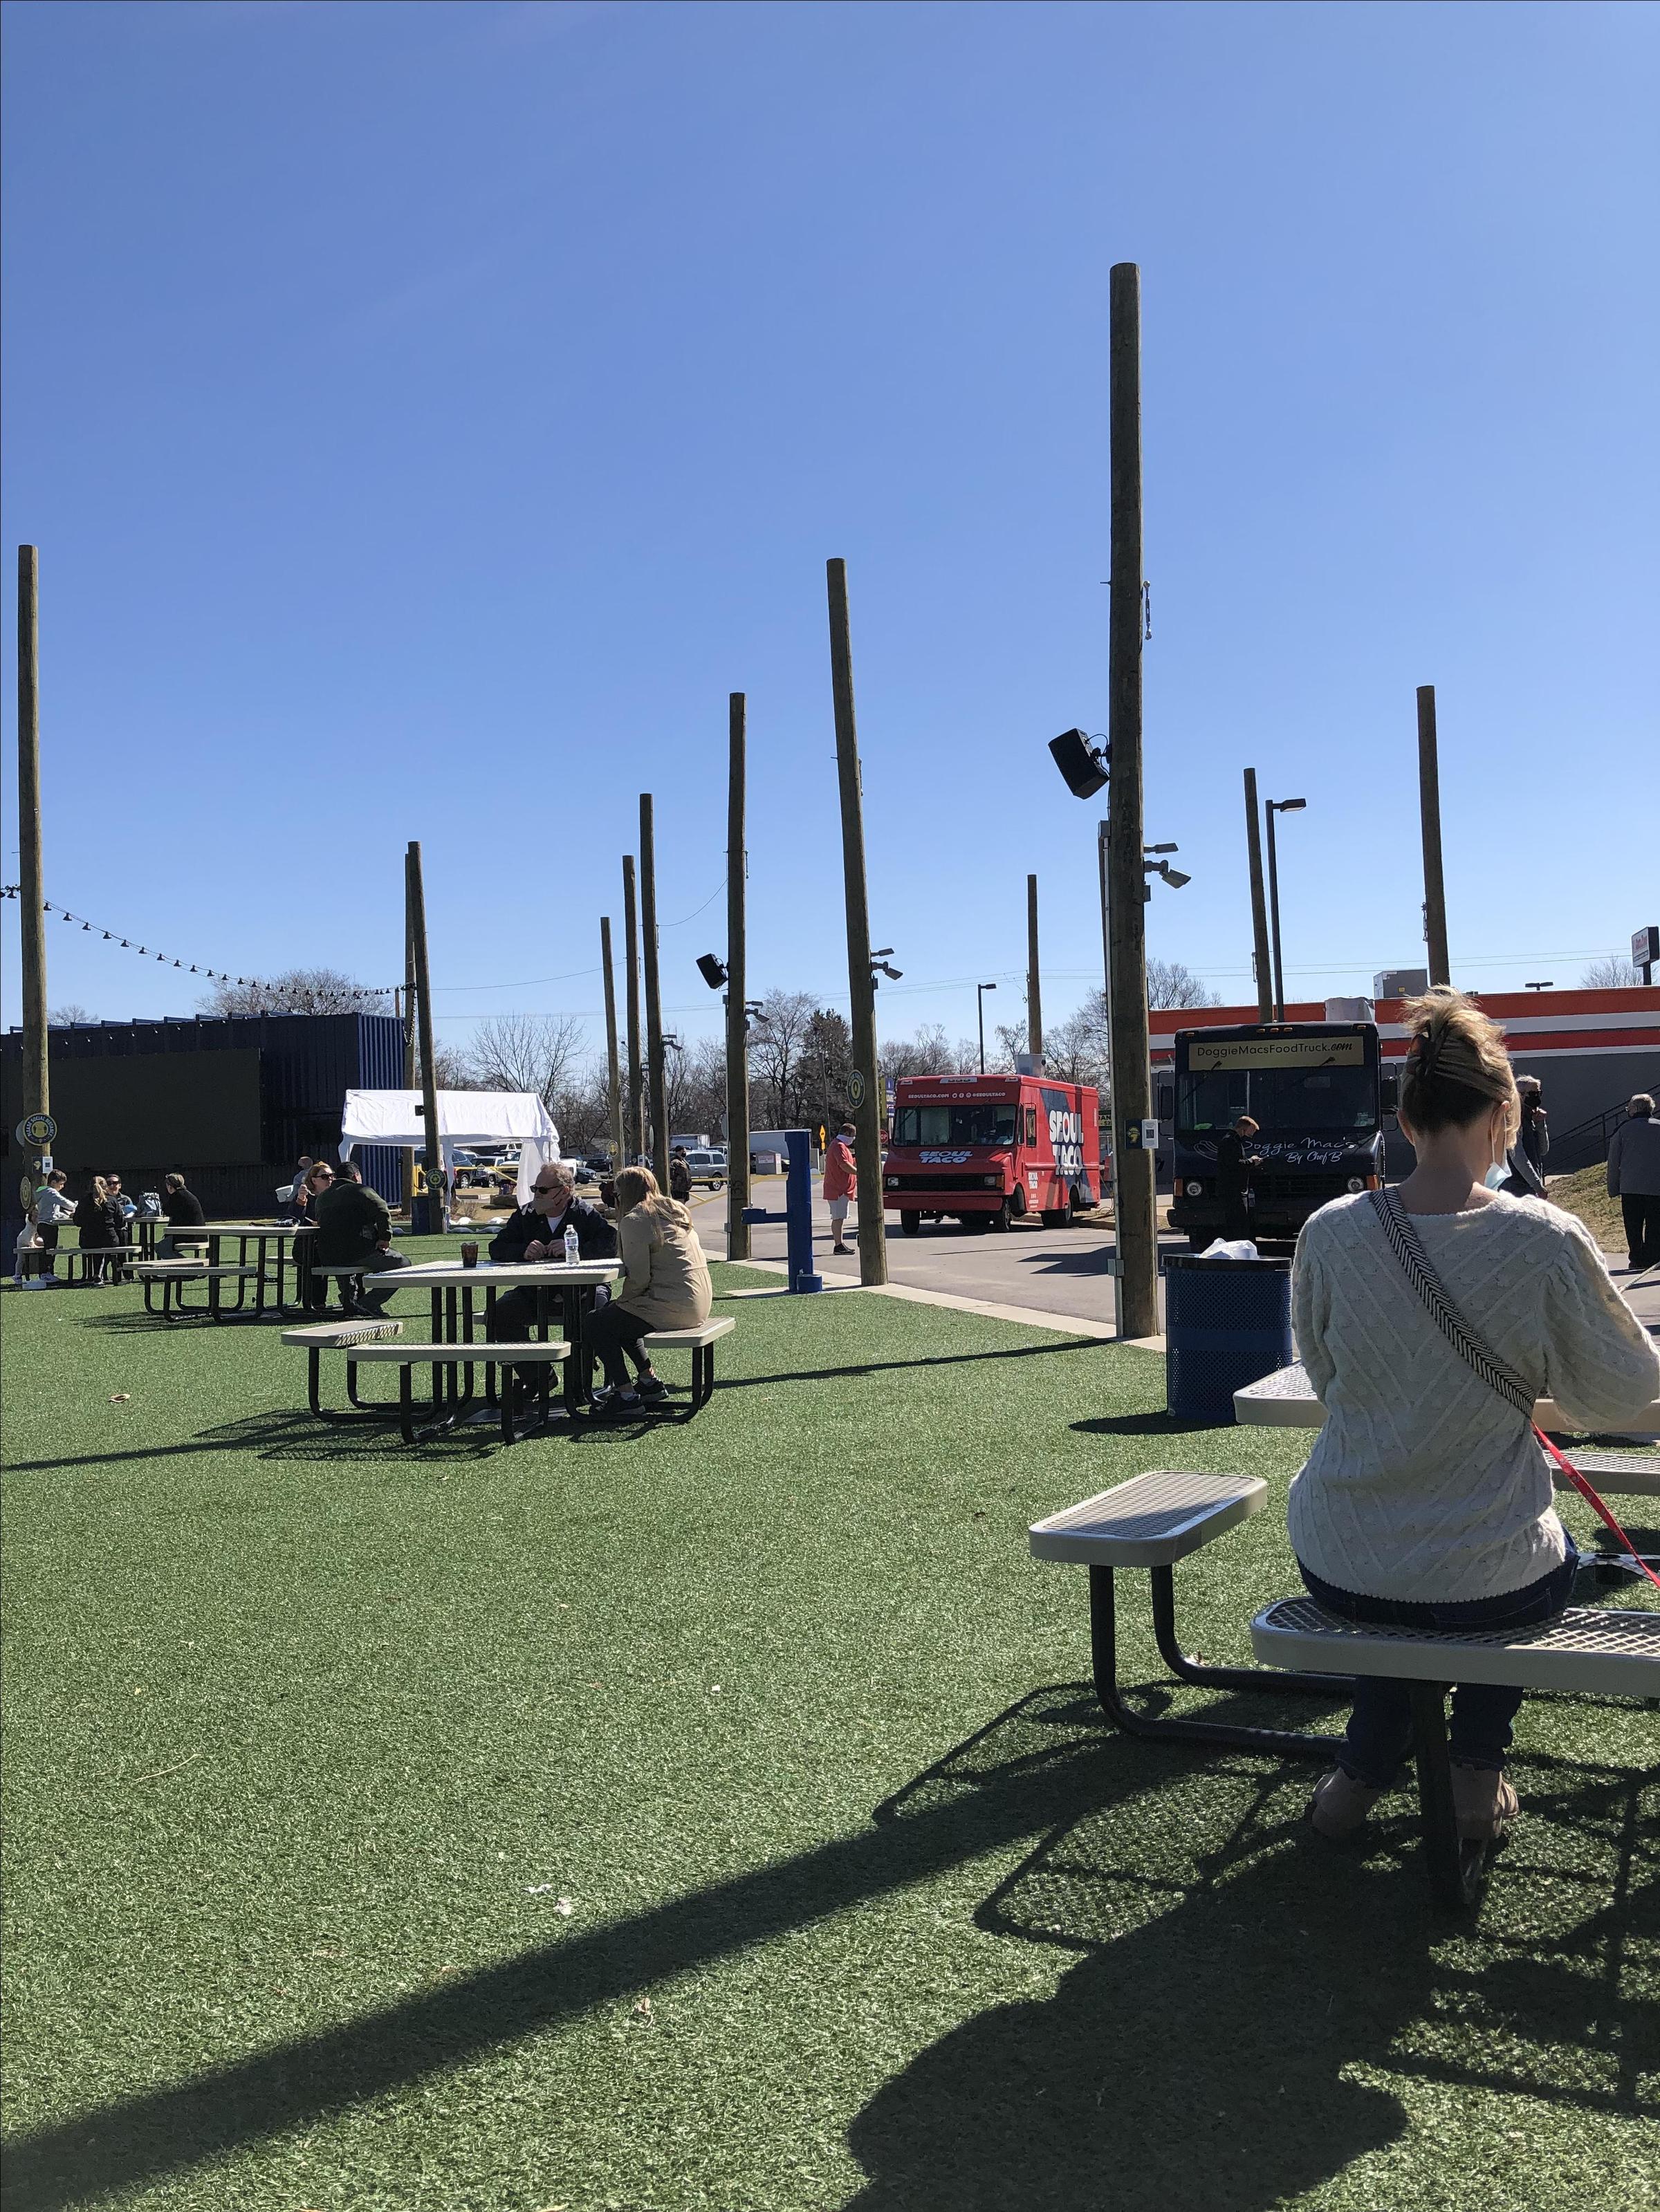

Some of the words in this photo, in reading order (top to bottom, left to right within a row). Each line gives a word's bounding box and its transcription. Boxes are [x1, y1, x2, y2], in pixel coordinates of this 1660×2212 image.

[1197, 1043, 1353, 1057] DoggieMacsFoodTruck.com
[1049, 1110, 1084, 1144] SEOUL
[1244, 1141, 1296, 1155] Doggie
[1052, 1144, 1083, 1175] TACO
[1285, 1151, 1303, 1164] By
[1307, 1151, 1329, 1164] Chef
[1329, 1151, 1343, 1162] B
